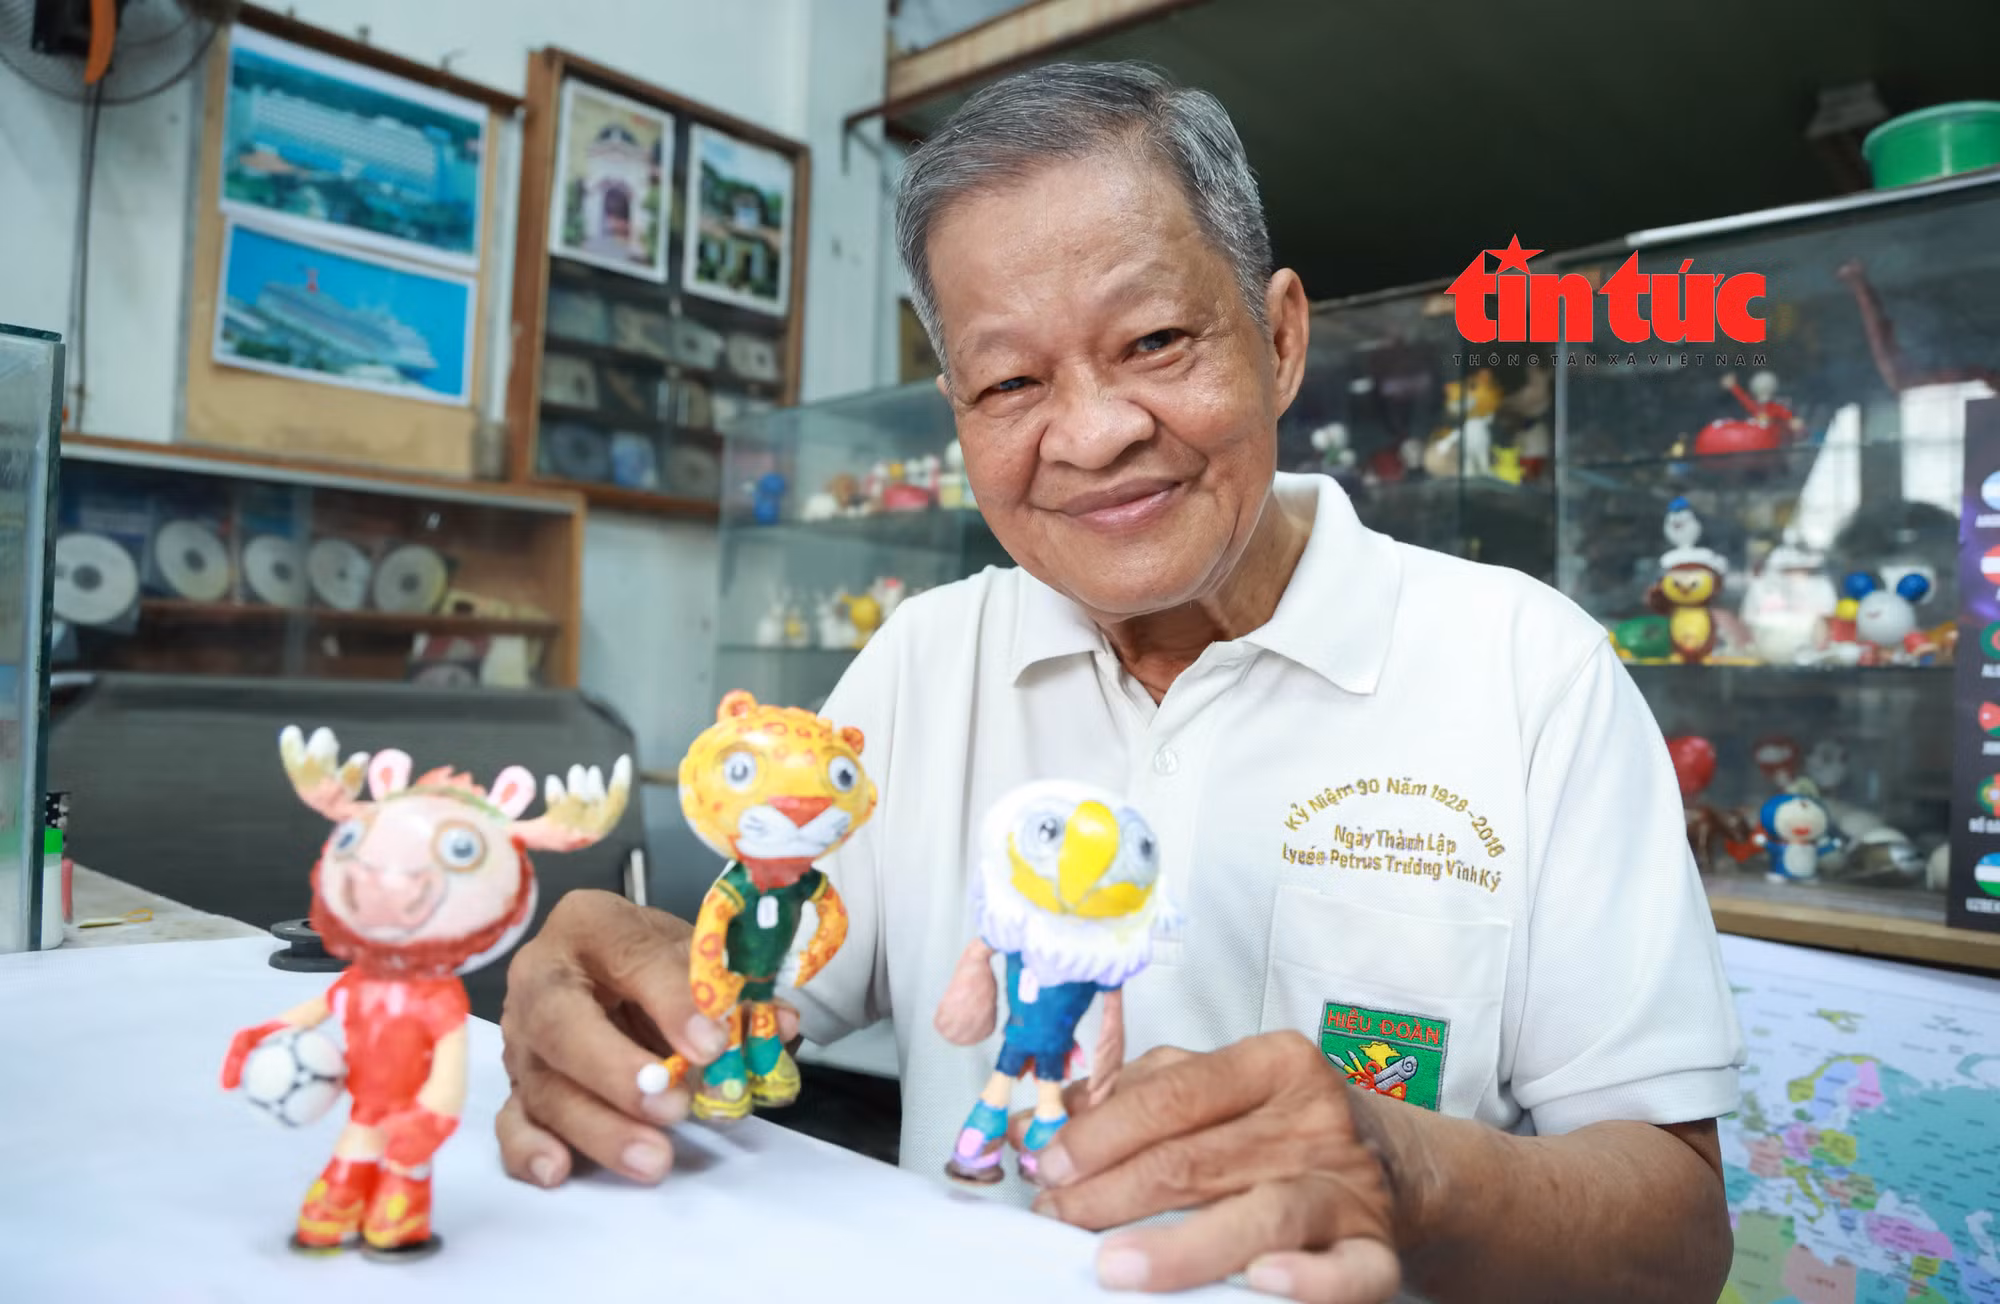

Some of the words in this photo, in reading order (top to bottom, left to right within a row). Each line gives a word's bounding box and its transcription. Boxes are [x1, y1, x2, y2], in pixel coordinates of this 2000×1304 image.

[1309, 784, 1354, 814] Niệm
[1357, 778, 1380, 795] 90
[1387, 777, 1427, 796] Năm
[1334, 825, 1373, 849] Ngày
[1376, 829, 1424, 851] Thành
[1427, 833, 1457, 856] Lập
[1330, 849, 1381, 870] Petrus
[1445, 860, 1477, 883] Vĩnh
[1479, 868, 1501, 893] Ký
[1327, 1008, 1371, 1034] HIỆU
[1378, 1019, 1440, 1045] ĐOÀN
